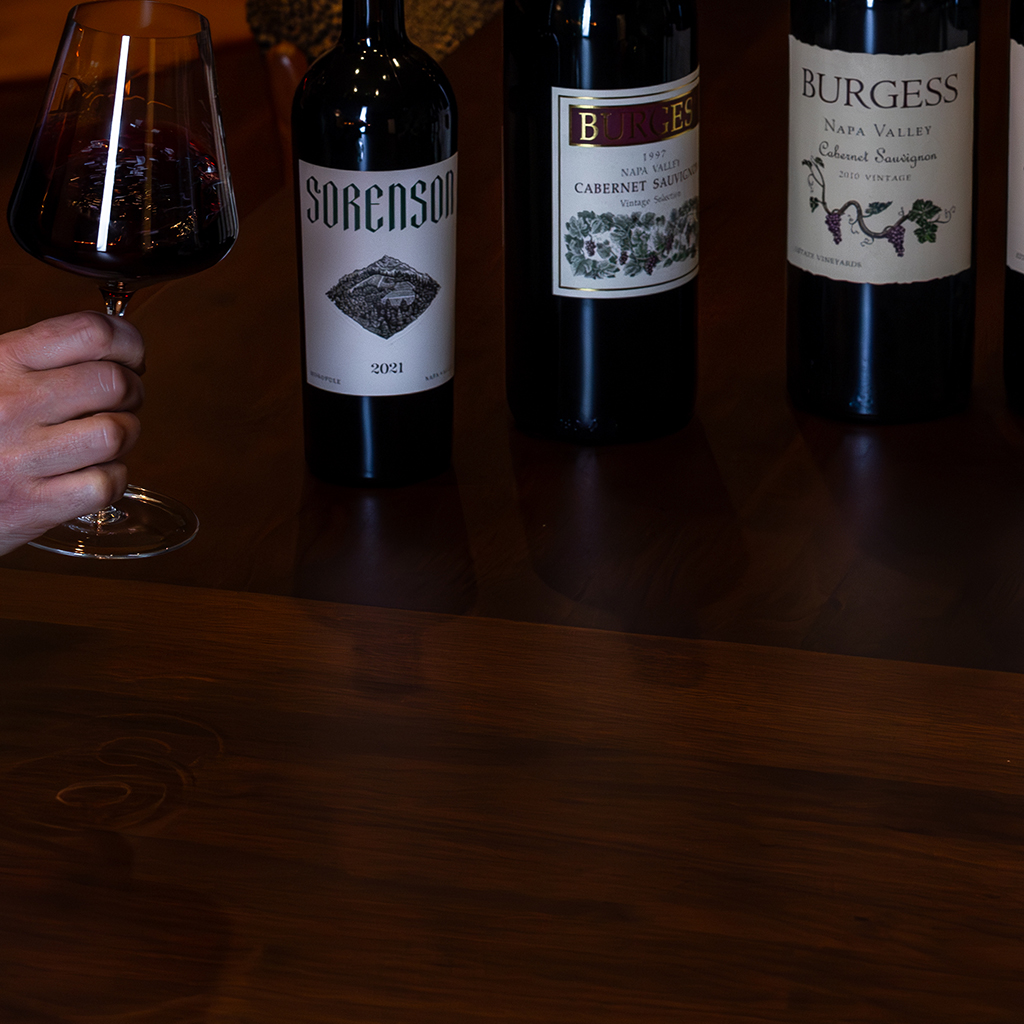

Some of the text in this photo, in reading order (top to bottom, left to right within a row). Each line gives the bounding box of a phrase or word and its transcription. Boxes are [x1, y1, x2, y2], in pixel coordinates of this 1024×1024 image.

[802, 67, 958, 109] BURGESS
[578, 96, 693, 141] BURGES
[824, 117, 932, 137] NAPA VALLEY
[642, 150, 667, 162] 1997
[818, 141, 937, 168] Cabernet Sauvignon
[621, 158, 680, 177] NAPA VALLEY
[865, 174, 912, 182] VINTAGE
[574, 180, 646, 194] CABERNET
[307, 170, 454, 232] SORENSON
[620, 198, 650, 208] Vintage
[816, 254, 863, 268] VINEYARDS
[371, 362, 404, 374] 2021
